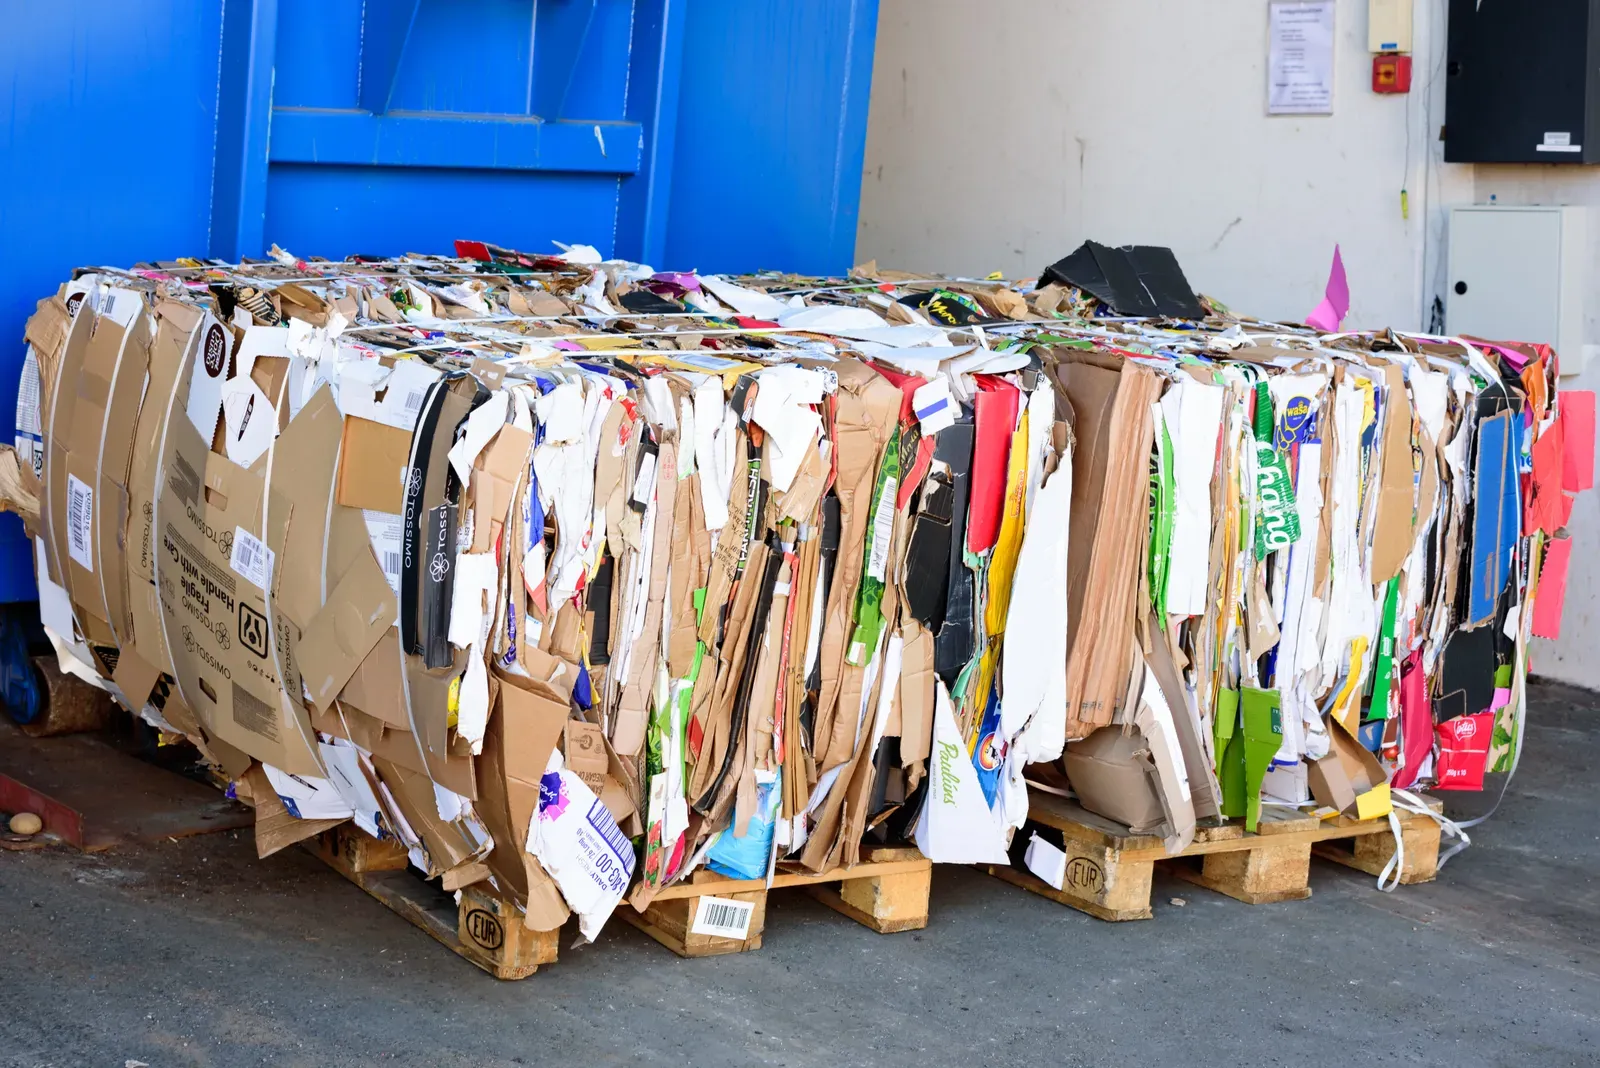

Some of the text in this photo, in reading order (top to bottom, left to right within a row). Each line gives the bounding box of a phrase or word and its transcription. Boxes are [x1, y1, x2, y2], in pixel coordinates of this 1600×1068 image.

[205, 330, 217, 365] Gusto
[208, 335, 221, 369] Dolce
[1287, 405, 1309, 416] wasa
[1256, 441, 1290, 550] Chang
[162, 535, 180, 563] Care
[180, 554, 199, 579] with
[180, 576, 210, 614] Fragile
[200, 574, 235, 613] Handle
[1073, 862, 1097, 887] EUR
[474, 914, 496, 944] EUR
